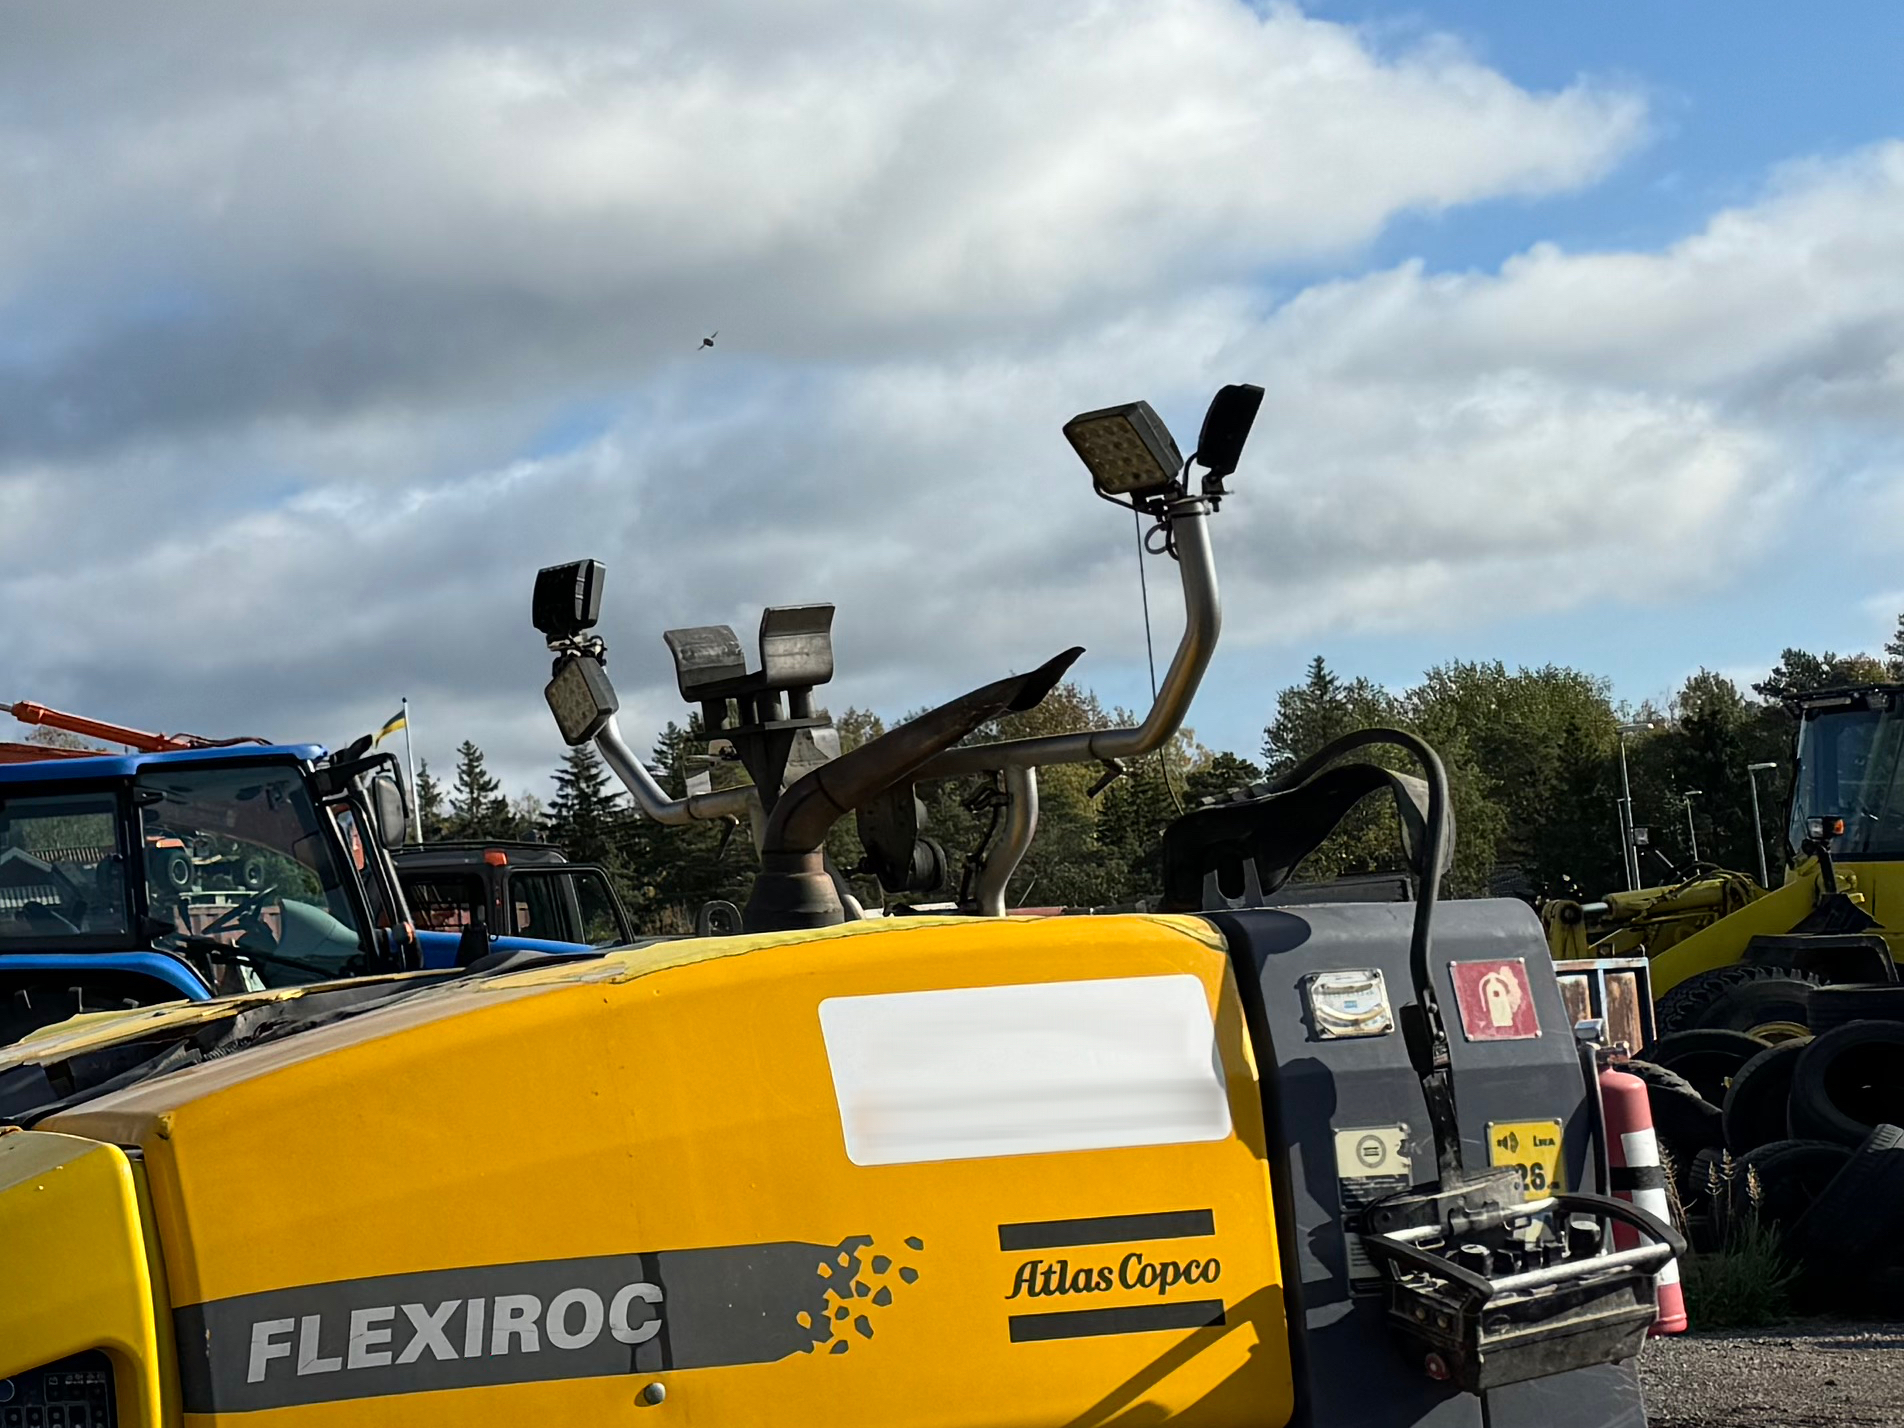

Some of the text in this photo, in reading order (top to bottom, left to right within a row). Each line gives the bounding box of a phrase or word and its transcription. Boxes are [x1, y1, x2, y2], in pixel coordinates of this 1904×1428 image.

[1004, 1252, 1222, 1300] Atlas Copco
[247, 1282, 664, 1384] FLEXIROC
